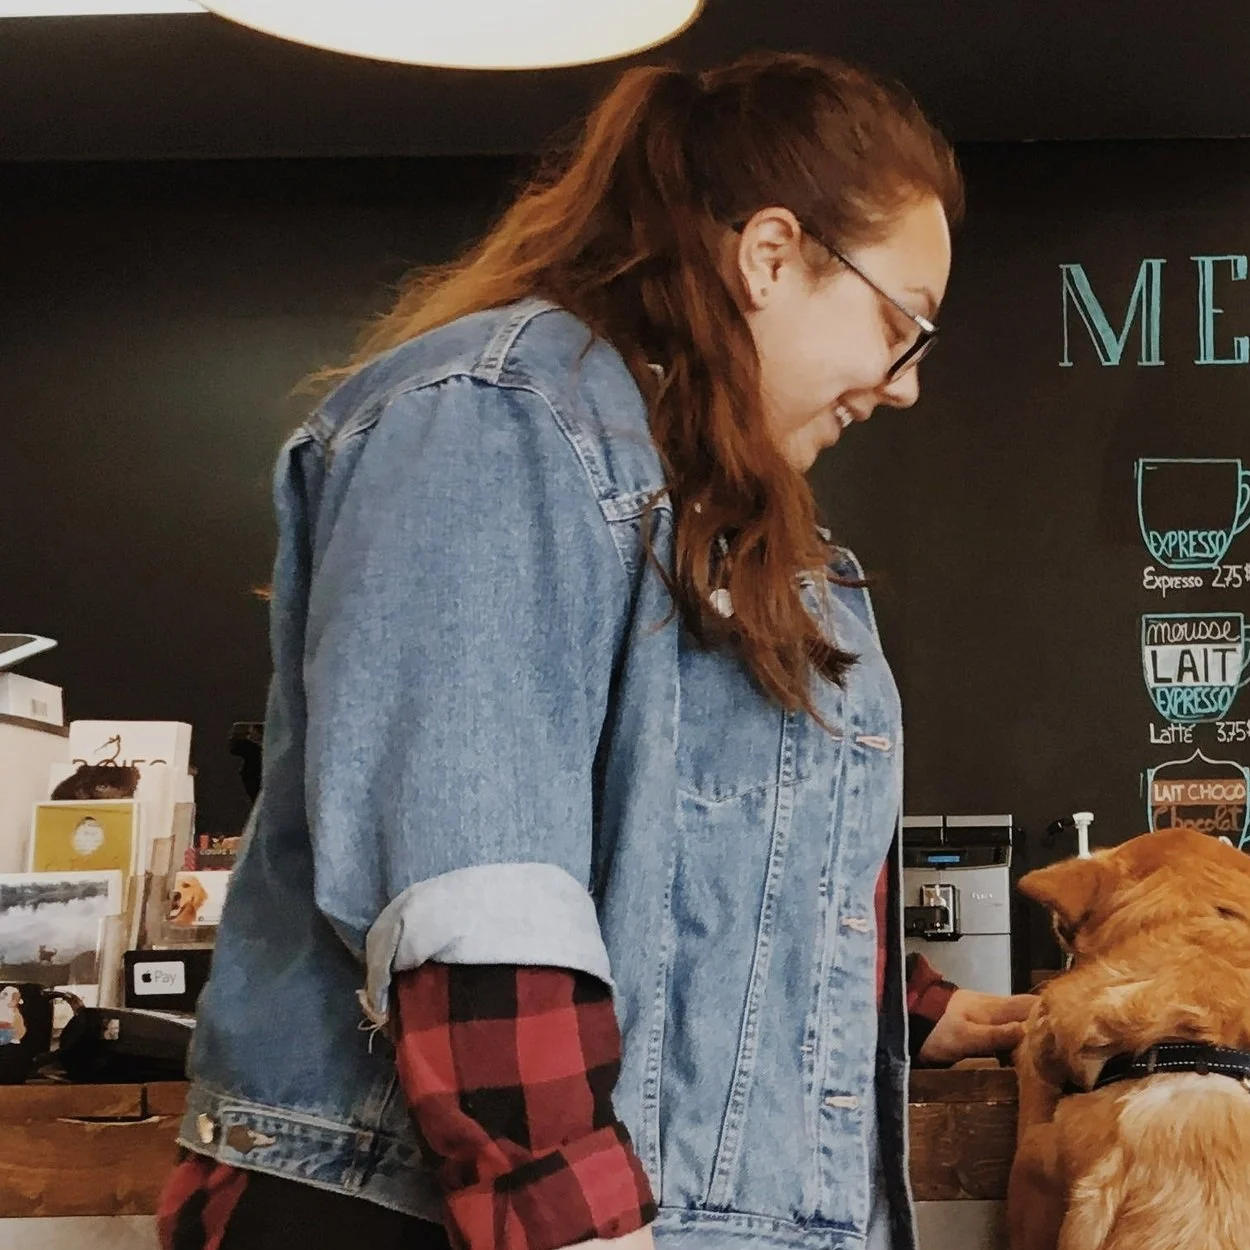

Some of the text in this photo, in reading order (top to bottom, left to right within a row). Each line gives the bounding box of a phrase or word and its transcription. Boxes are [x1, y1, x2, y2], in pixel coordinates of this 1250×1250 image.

[1150, 530, 1227, 558] EXPRESSO
[1143, 566, 1204, 598] Expresso
[1147, 621, 1240, 645] mousse
[1151, 648, 1237, 683] LAIT
[1156, 687, 1231, 715] EXPRESSO
[1154, 783, 1245, 802] LAIT CHOCO
[154, 971, 177, 986] Pay
